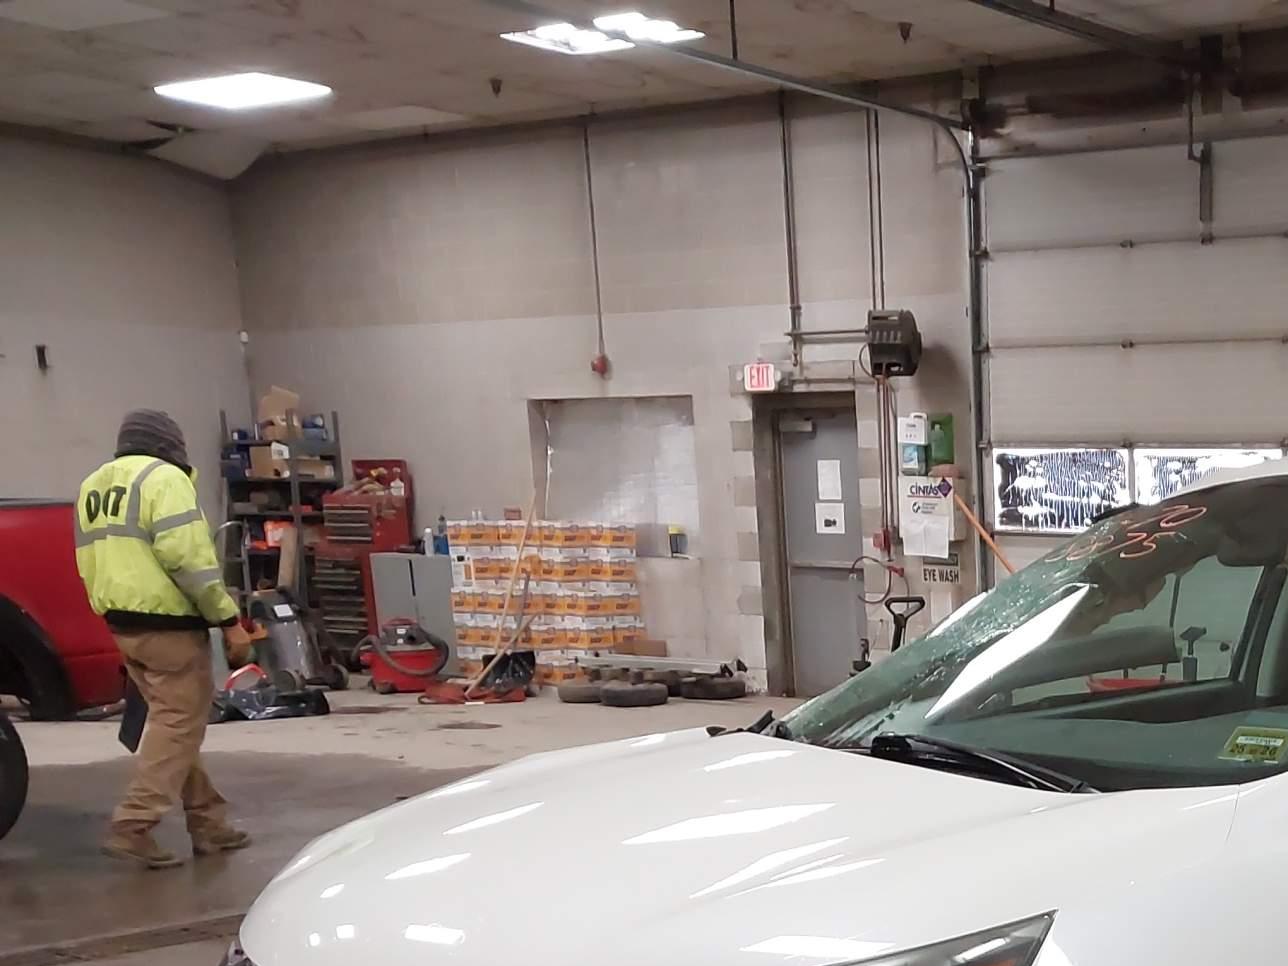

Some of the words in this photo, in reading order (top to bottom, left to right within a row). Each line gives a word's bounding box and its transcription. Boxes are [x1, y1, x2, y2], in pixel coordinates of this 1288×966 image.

[750, 365, 769, 388] EXIT
[909, 481, 939, 496] CINTAS
[922, 567, 937, 582] EYE
[938, 568, 959, 583] WASH
